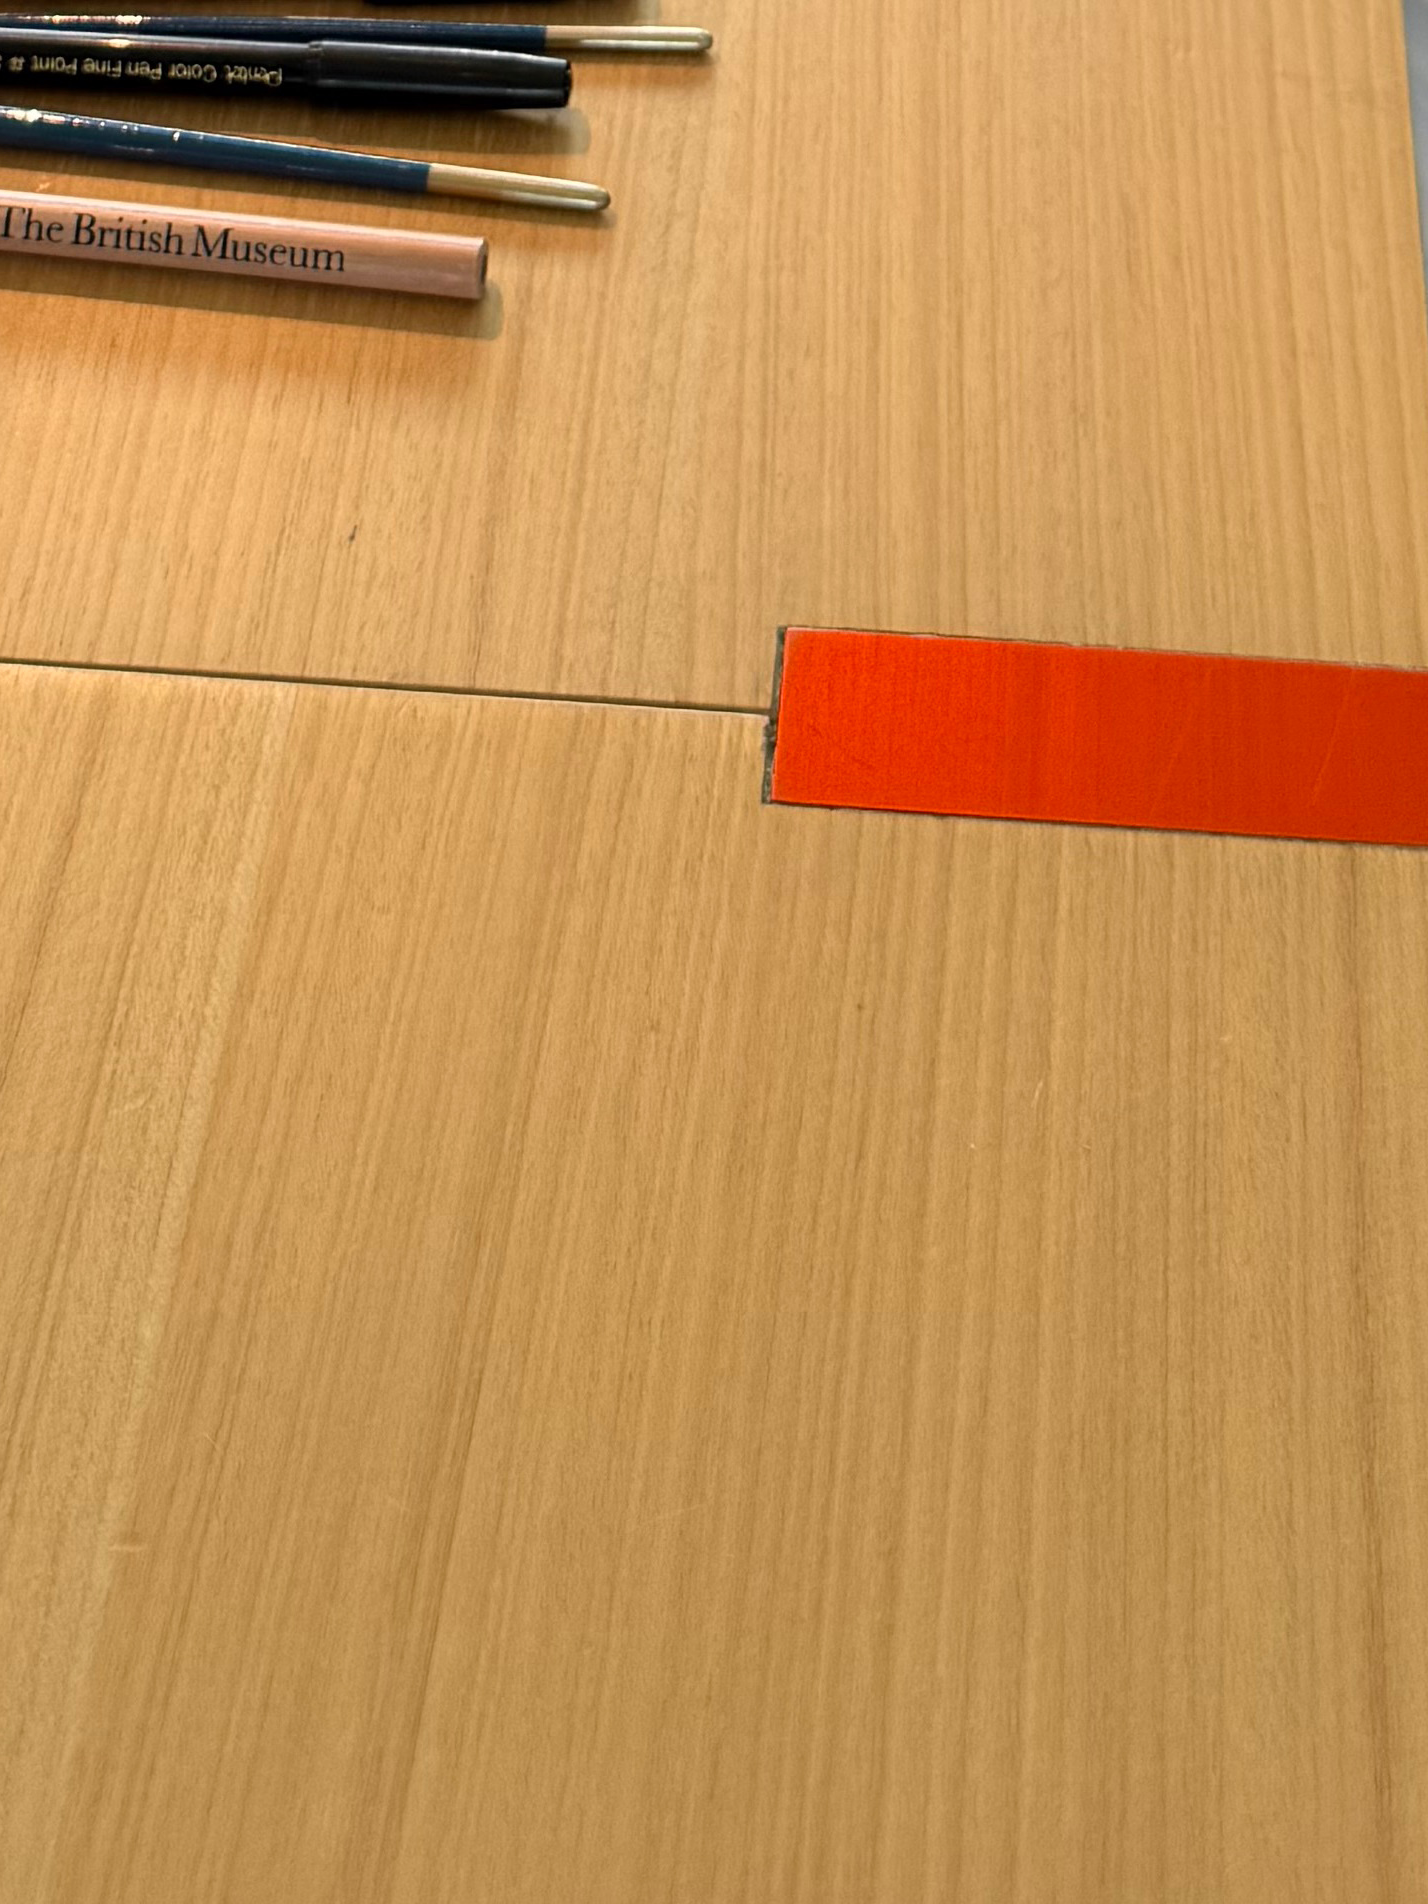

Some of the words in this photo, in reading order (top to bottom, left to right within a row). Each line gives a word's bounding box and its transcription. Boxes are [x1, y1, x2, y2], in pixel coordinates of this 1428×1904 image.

[31, 55, 77, 75] Point
[81, 57, 122, 78] Fine
[125, 60, 163, 80] Pen
[168, 63, 217, 84] Color
[72, 212, 184, 256] British
[191, 224, 346, 272] Museum
